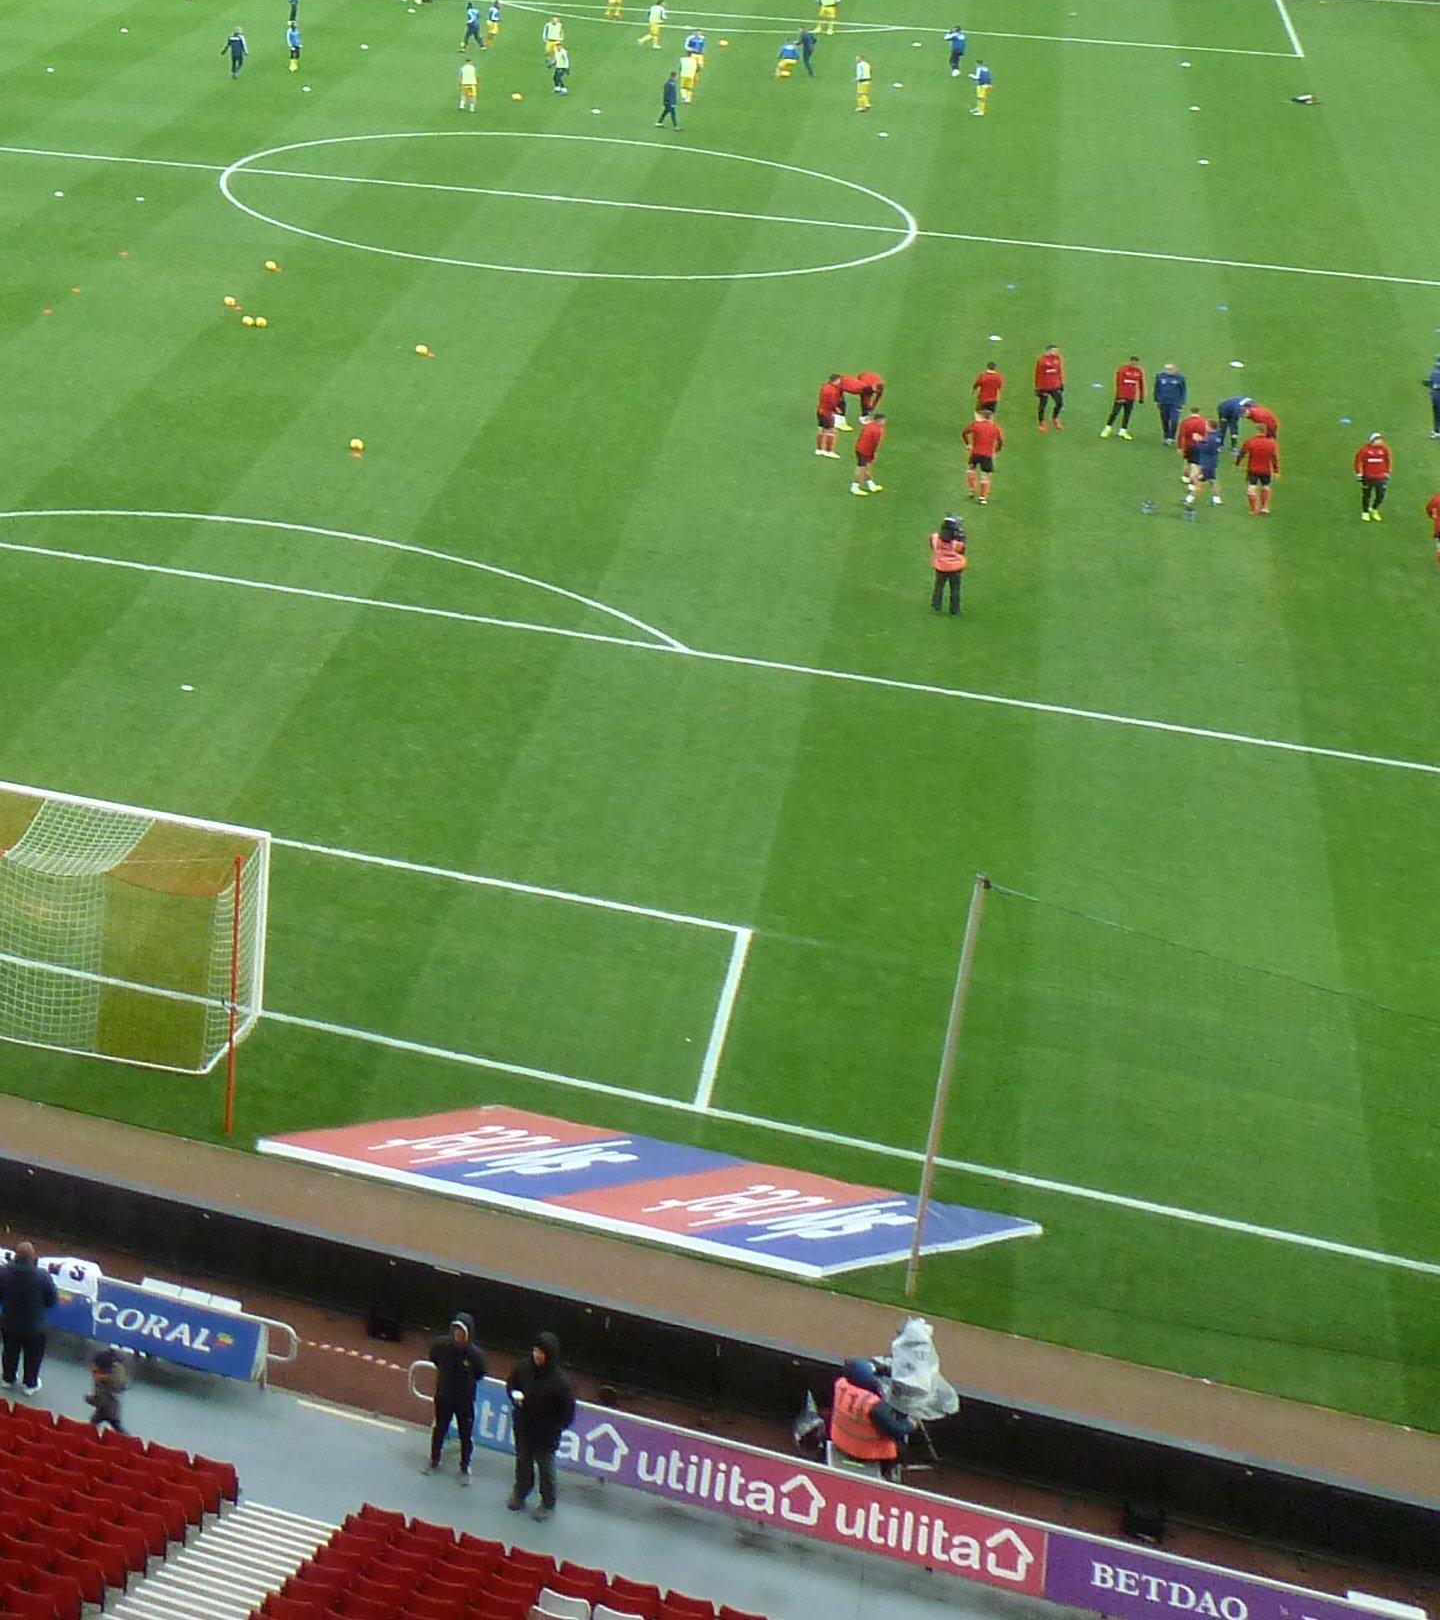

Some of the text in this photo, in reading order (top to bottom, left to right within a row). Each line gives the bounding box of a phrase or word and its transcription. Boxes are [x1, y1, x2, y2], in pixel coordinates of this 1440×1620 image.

[93, 1299, 213, 1352] CORAL
[637, 1447, 981, 1571] utilita utilita
